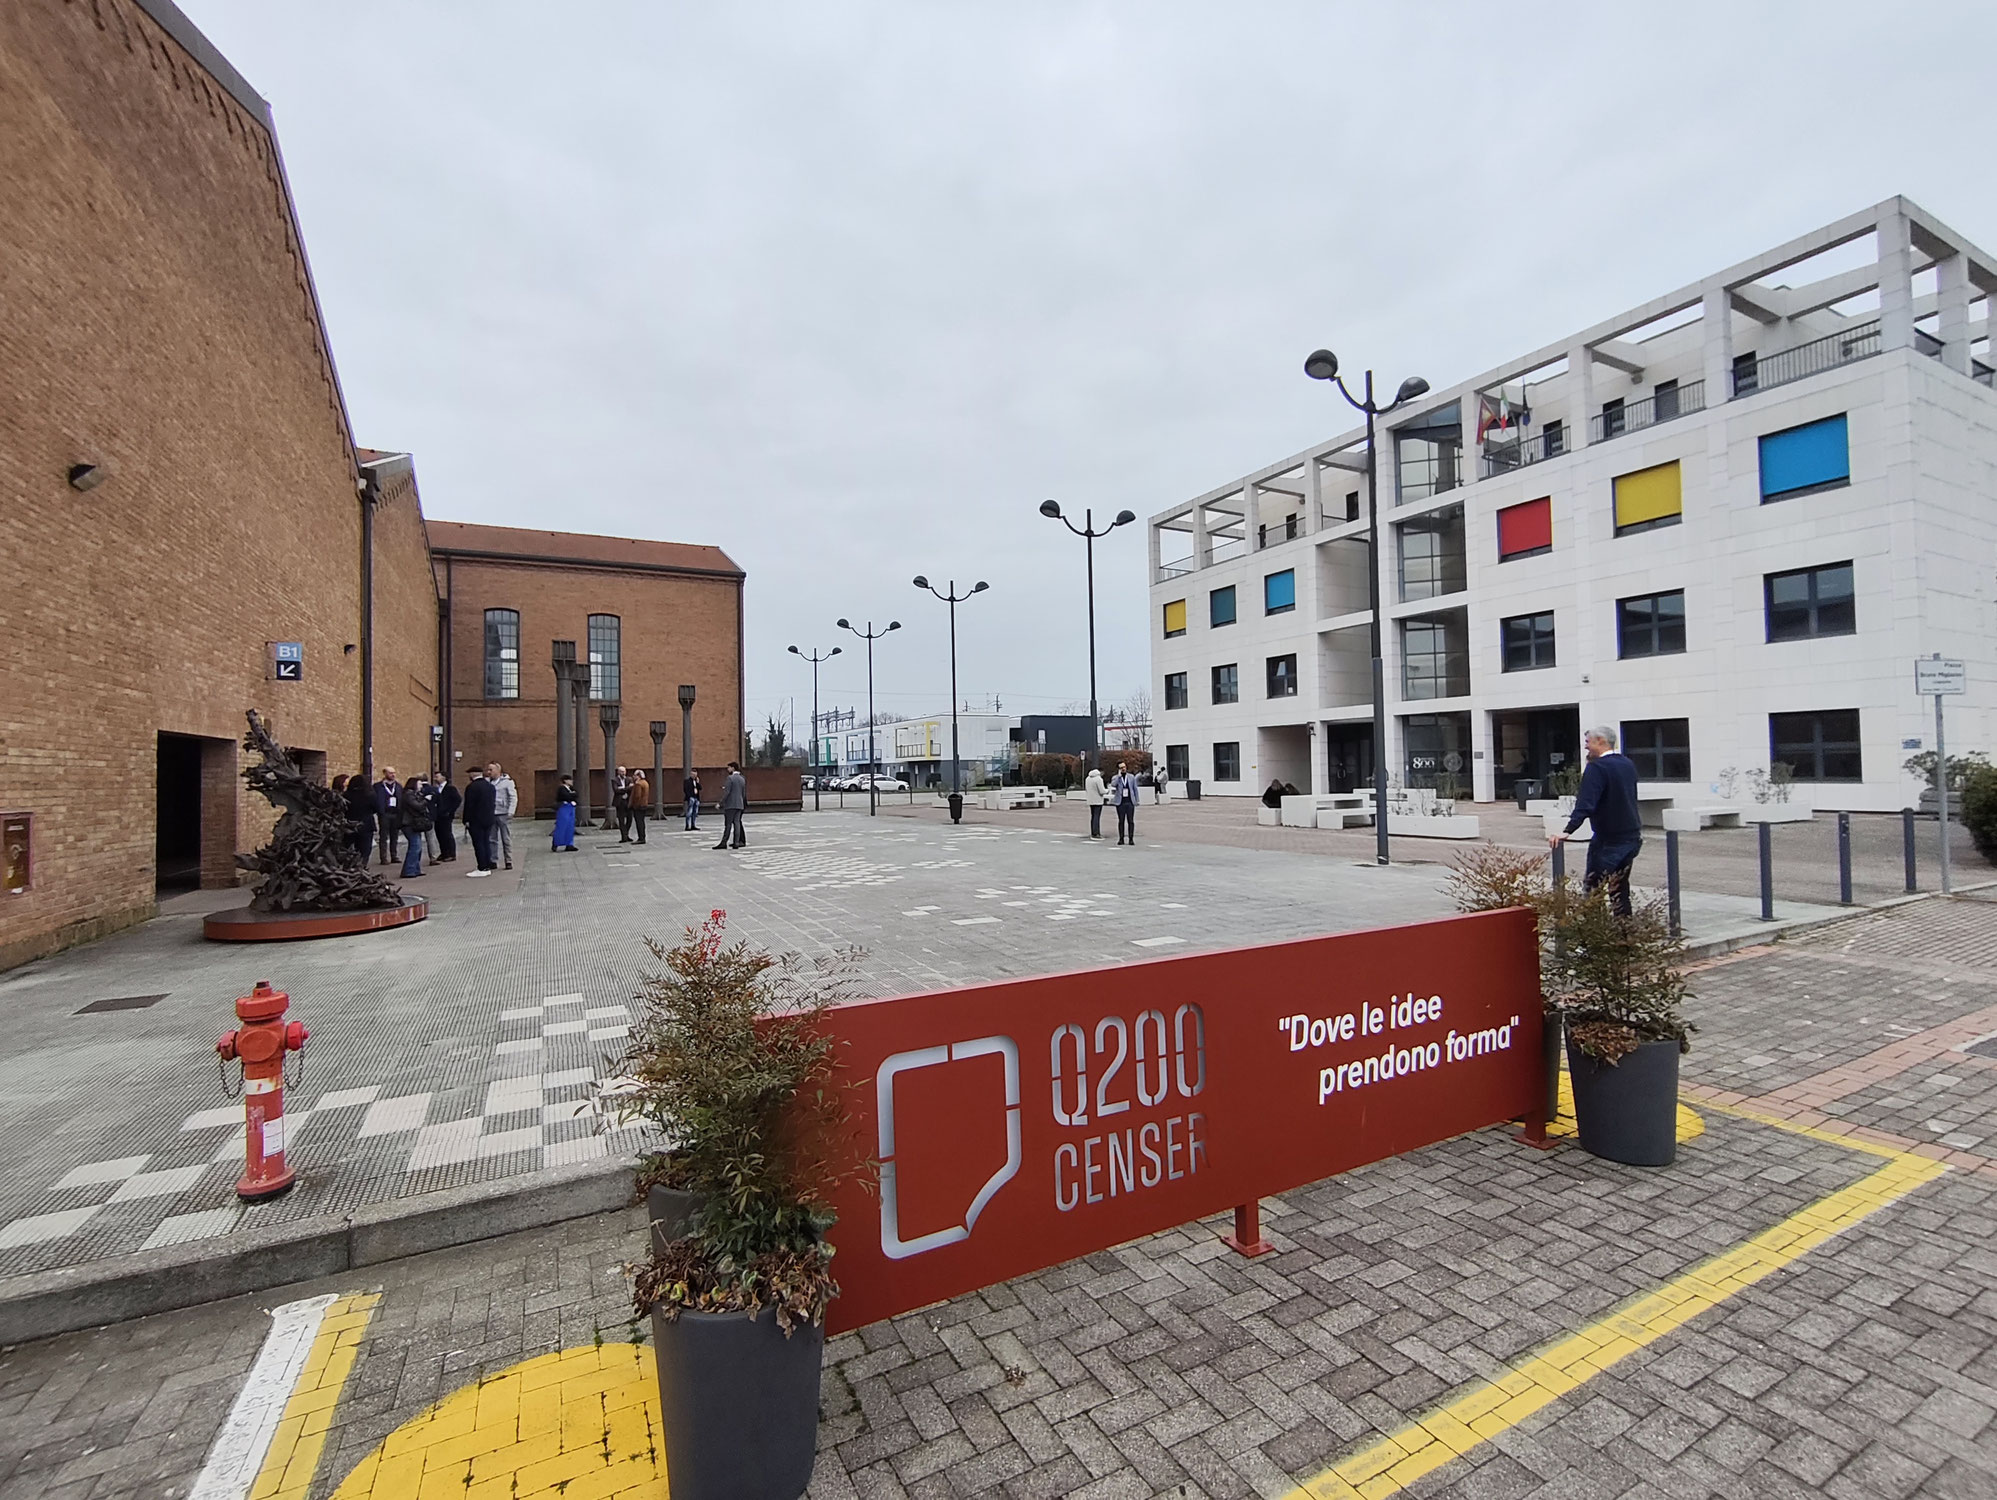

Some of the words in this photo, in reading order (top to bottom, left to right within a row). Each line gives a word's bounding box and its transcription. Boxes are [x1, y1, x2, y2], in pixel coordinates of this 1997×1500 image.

[279, 646, 298, 658] B1
[1050, 1001, 1207, 1126] Q200
[1278, 1012, 1355, 1052] "Dove
[1361, 1001, 1384, 1036] le
[1390, 992, 1442, 1030] idee
[1318, 1044, 1440, 1105] prendono
[1445, 1015, 1520, 1063] forma"
[1054, 1112, 1211, 1212] CENSER
